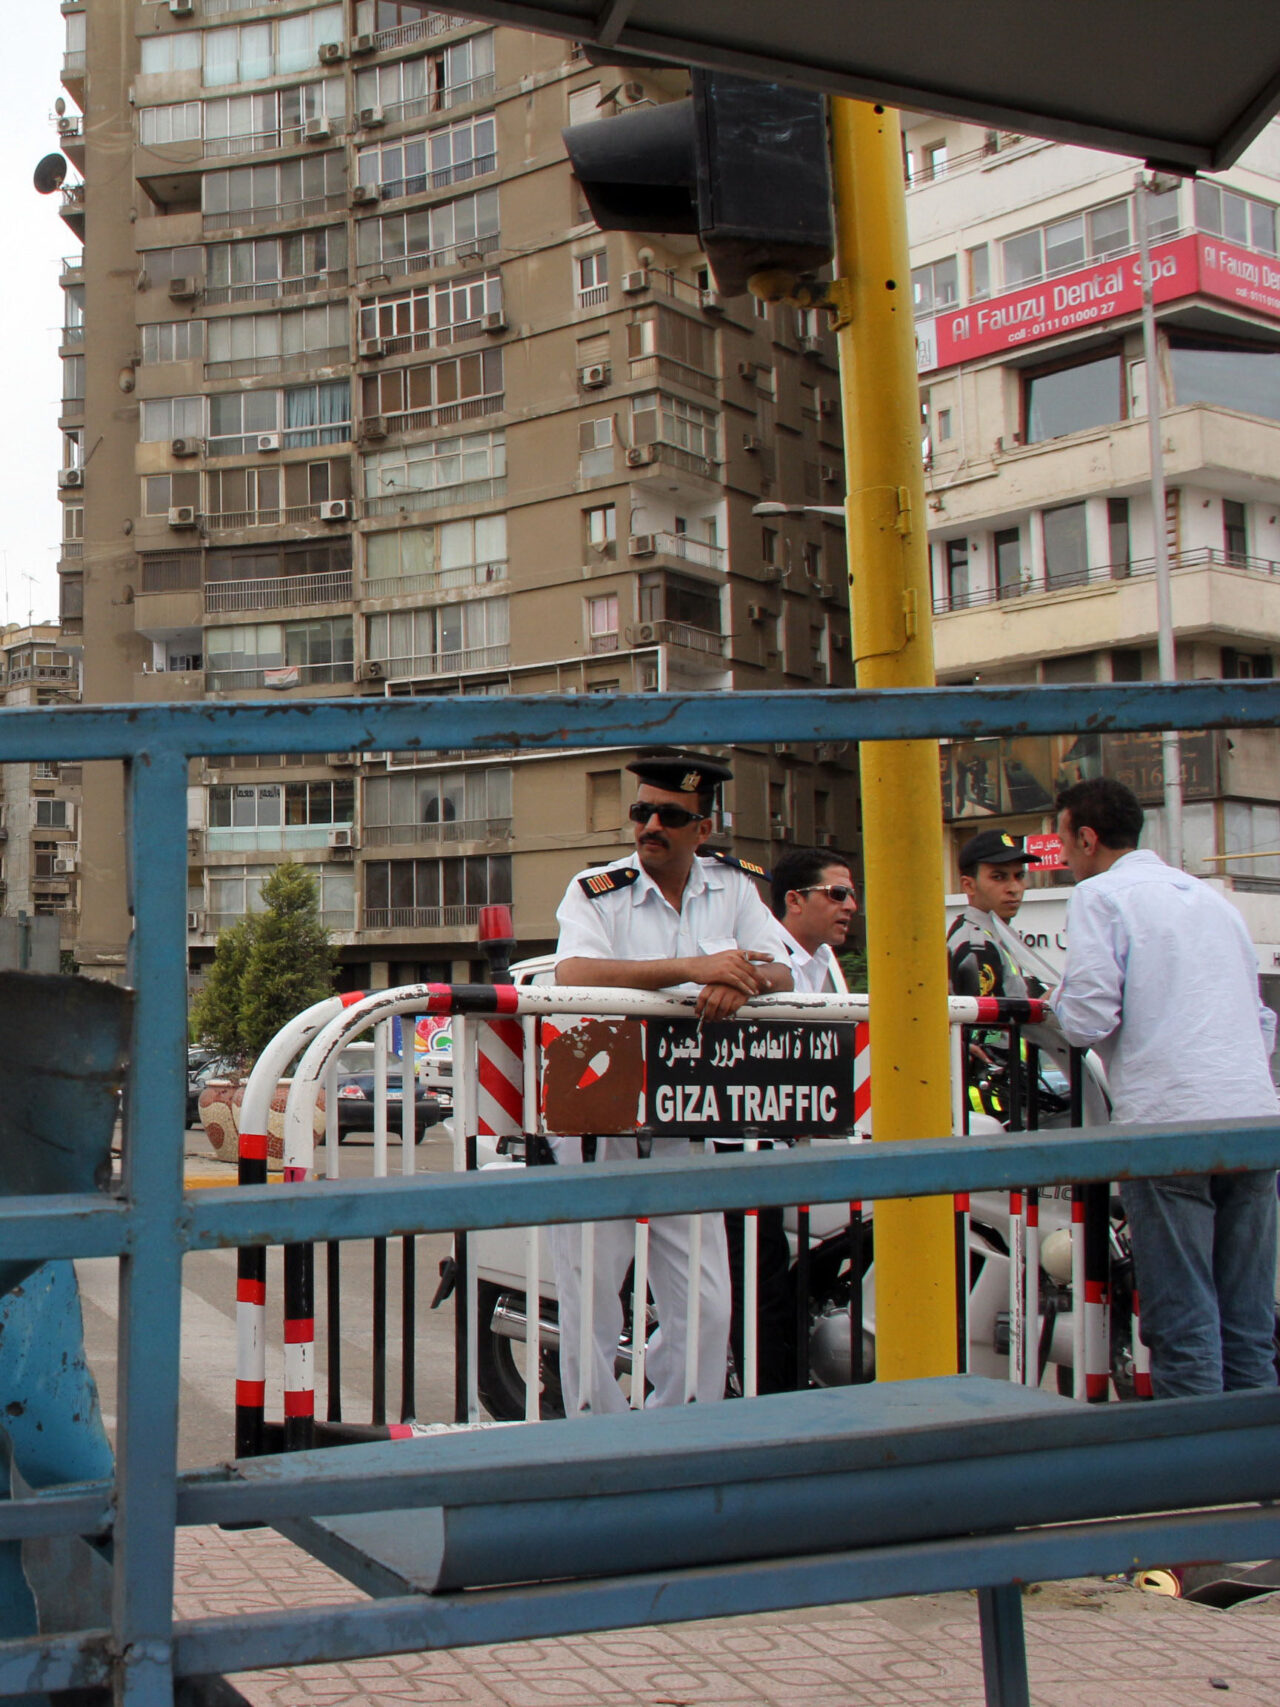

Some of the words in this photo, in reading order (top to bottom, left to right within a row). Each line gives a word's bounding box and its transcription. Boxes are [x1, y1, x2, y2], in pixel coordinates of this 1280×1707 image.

[977, 295, 1046, 335] Fawzy
[1053, 265, 1124, 312] Dental
[1132, 255, 1177, 288] Spa
[655, 1084, 721, 1123] GIZA
[726, 1084, 838, 1123] TRAFFIC
